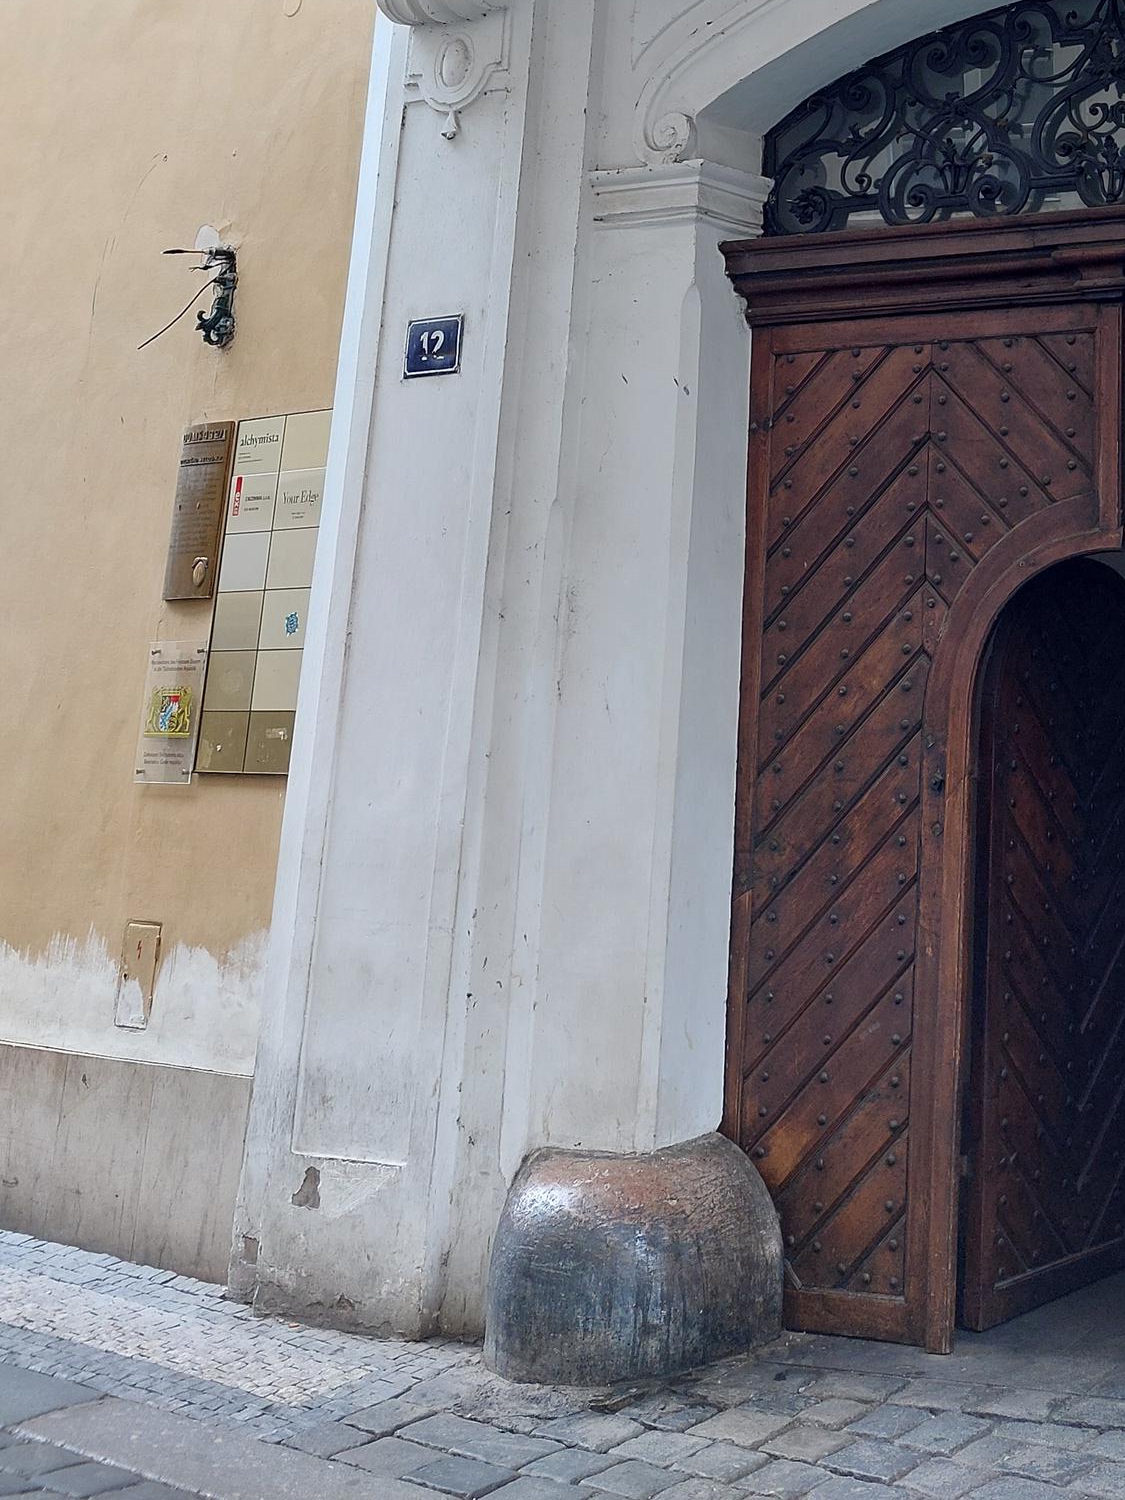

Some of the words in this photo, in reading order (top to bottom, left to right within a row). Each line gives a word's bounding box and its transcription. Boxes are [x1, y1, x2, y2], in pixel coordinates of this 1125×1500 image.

[419, 330, 445, 361] 12
[240, 433, 280, 448] alchymista
[283, 491, 299, 505] Your
[300, 488, 320, 506] Edge
